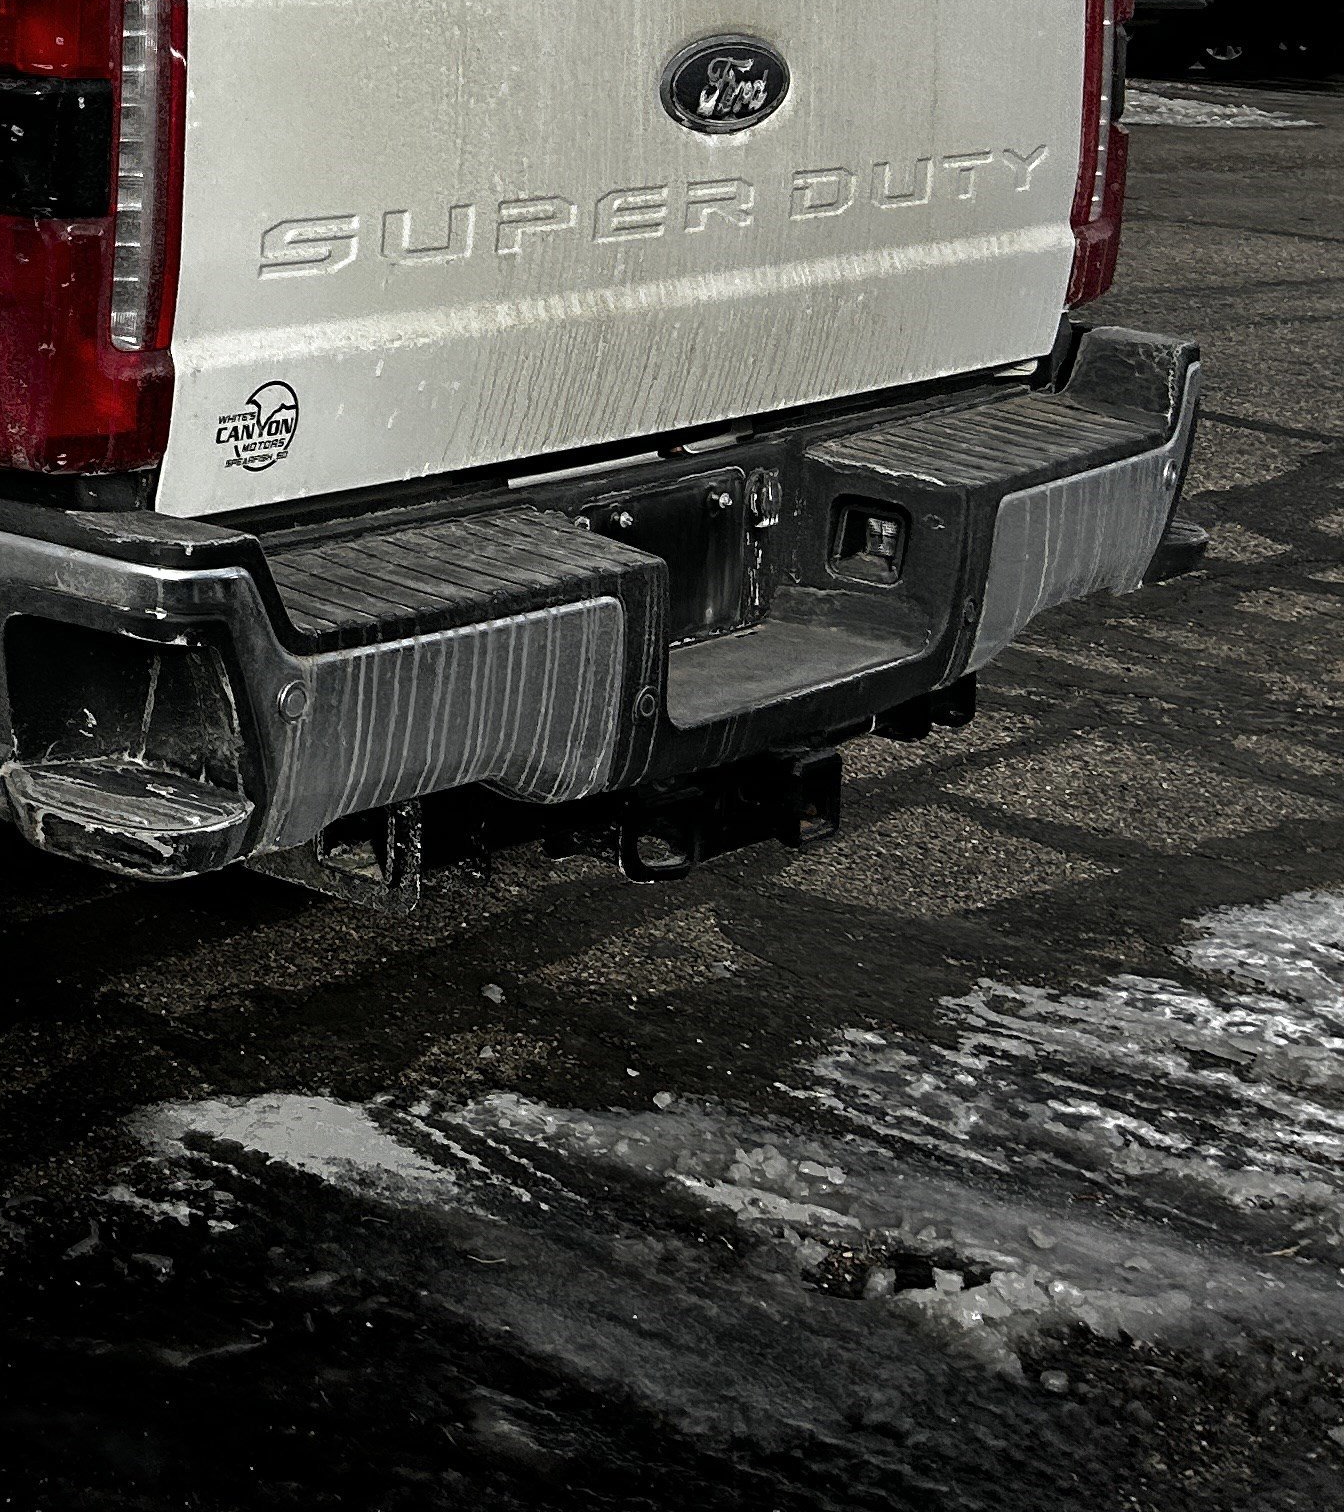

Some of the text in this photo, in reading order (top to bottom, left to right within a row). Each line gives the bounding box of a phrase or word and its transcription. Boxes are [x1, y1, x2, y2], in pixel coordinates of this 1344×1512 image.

[258, 143, 1050, 280] SUPER DUTY
[216, 418, 294, 444] CANYON
[242, 438, 286, 452] MOTORS
